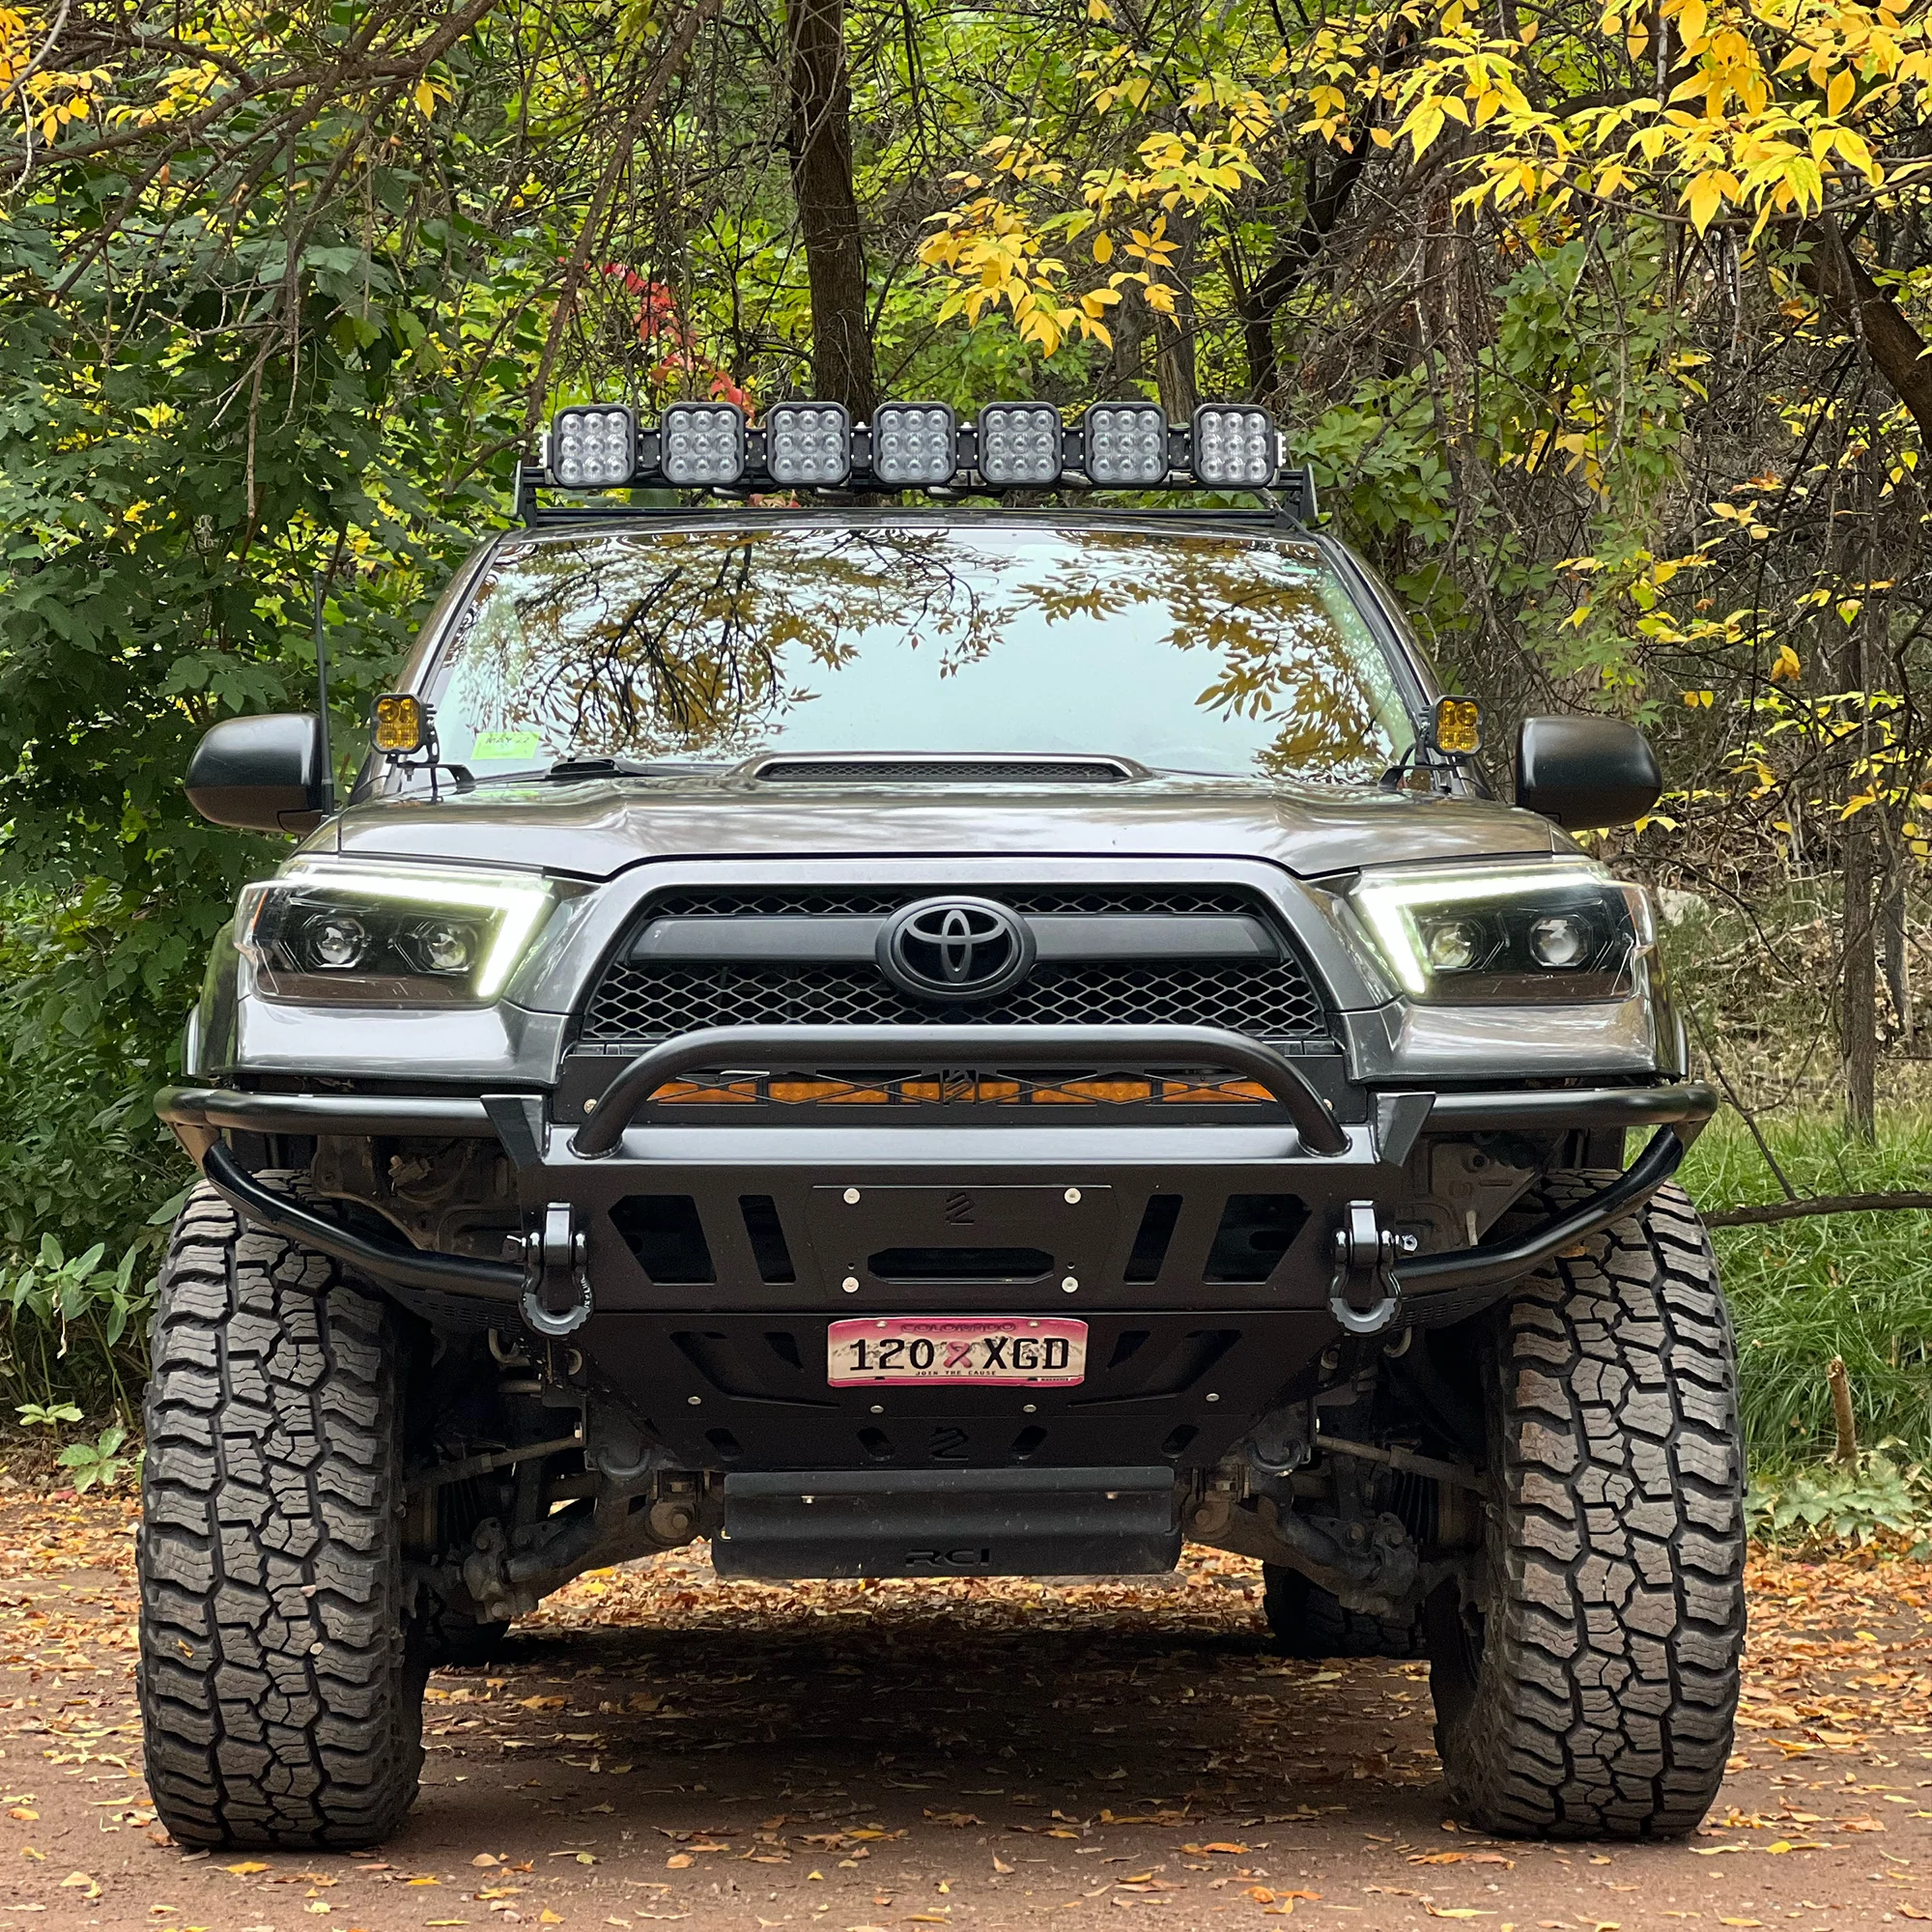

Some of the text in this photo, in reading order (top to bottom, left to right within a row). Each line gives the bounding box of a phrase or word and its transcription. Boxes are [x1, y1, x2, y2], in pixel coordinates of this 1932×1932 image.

[900, 1322, 1016, 1333] COLORADO
[850, 1338, 1069, 1371] 120 XGD
[905, 1548, 990, 1568] RCI
